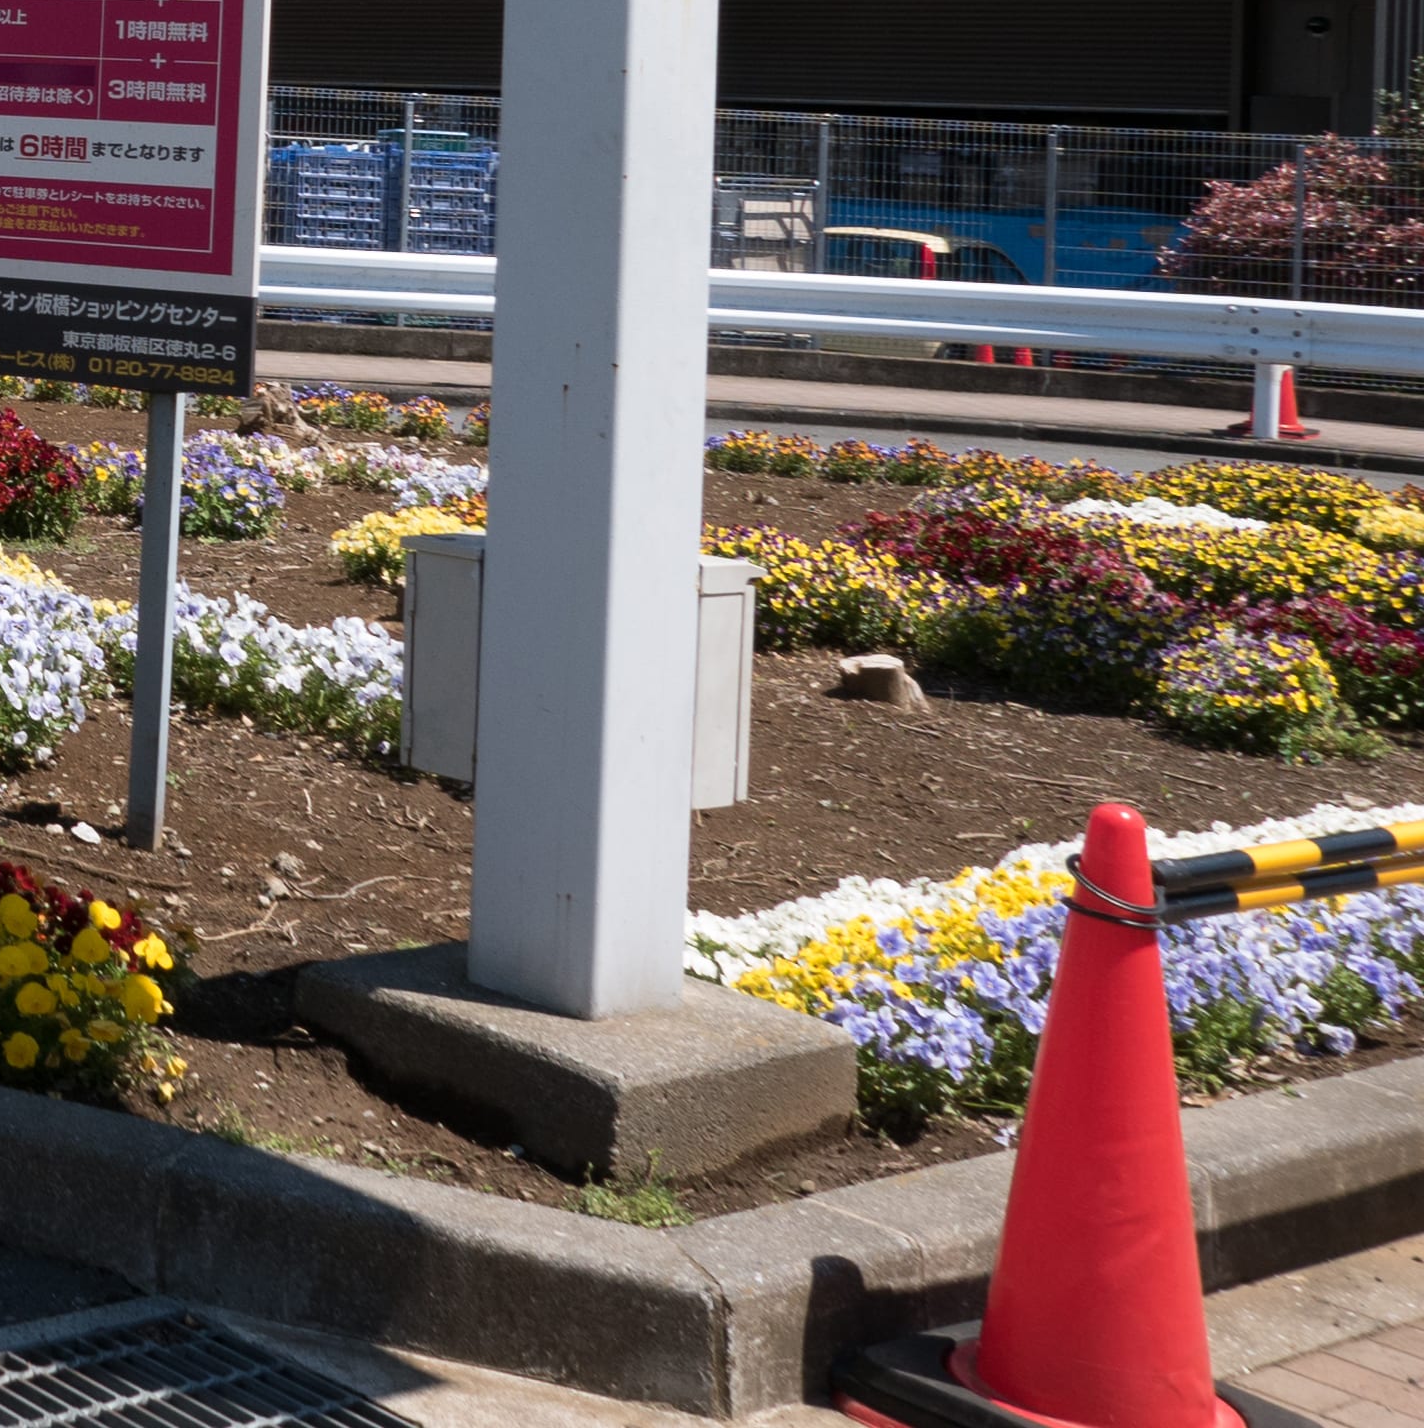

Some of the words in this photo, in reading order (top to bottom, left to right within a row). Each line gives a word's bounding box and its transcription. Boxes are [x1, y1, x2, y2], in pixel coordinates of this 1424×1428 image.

[115, 19, 208, 42] 1時間無料
[108, 80, 206, 103] 3時間無料
[19, 134, 87, 160] 6時間
[92, 141, 205, 163] までとなります
[62, 330, 237, 361] 東京都板橋区徳丸2-6
